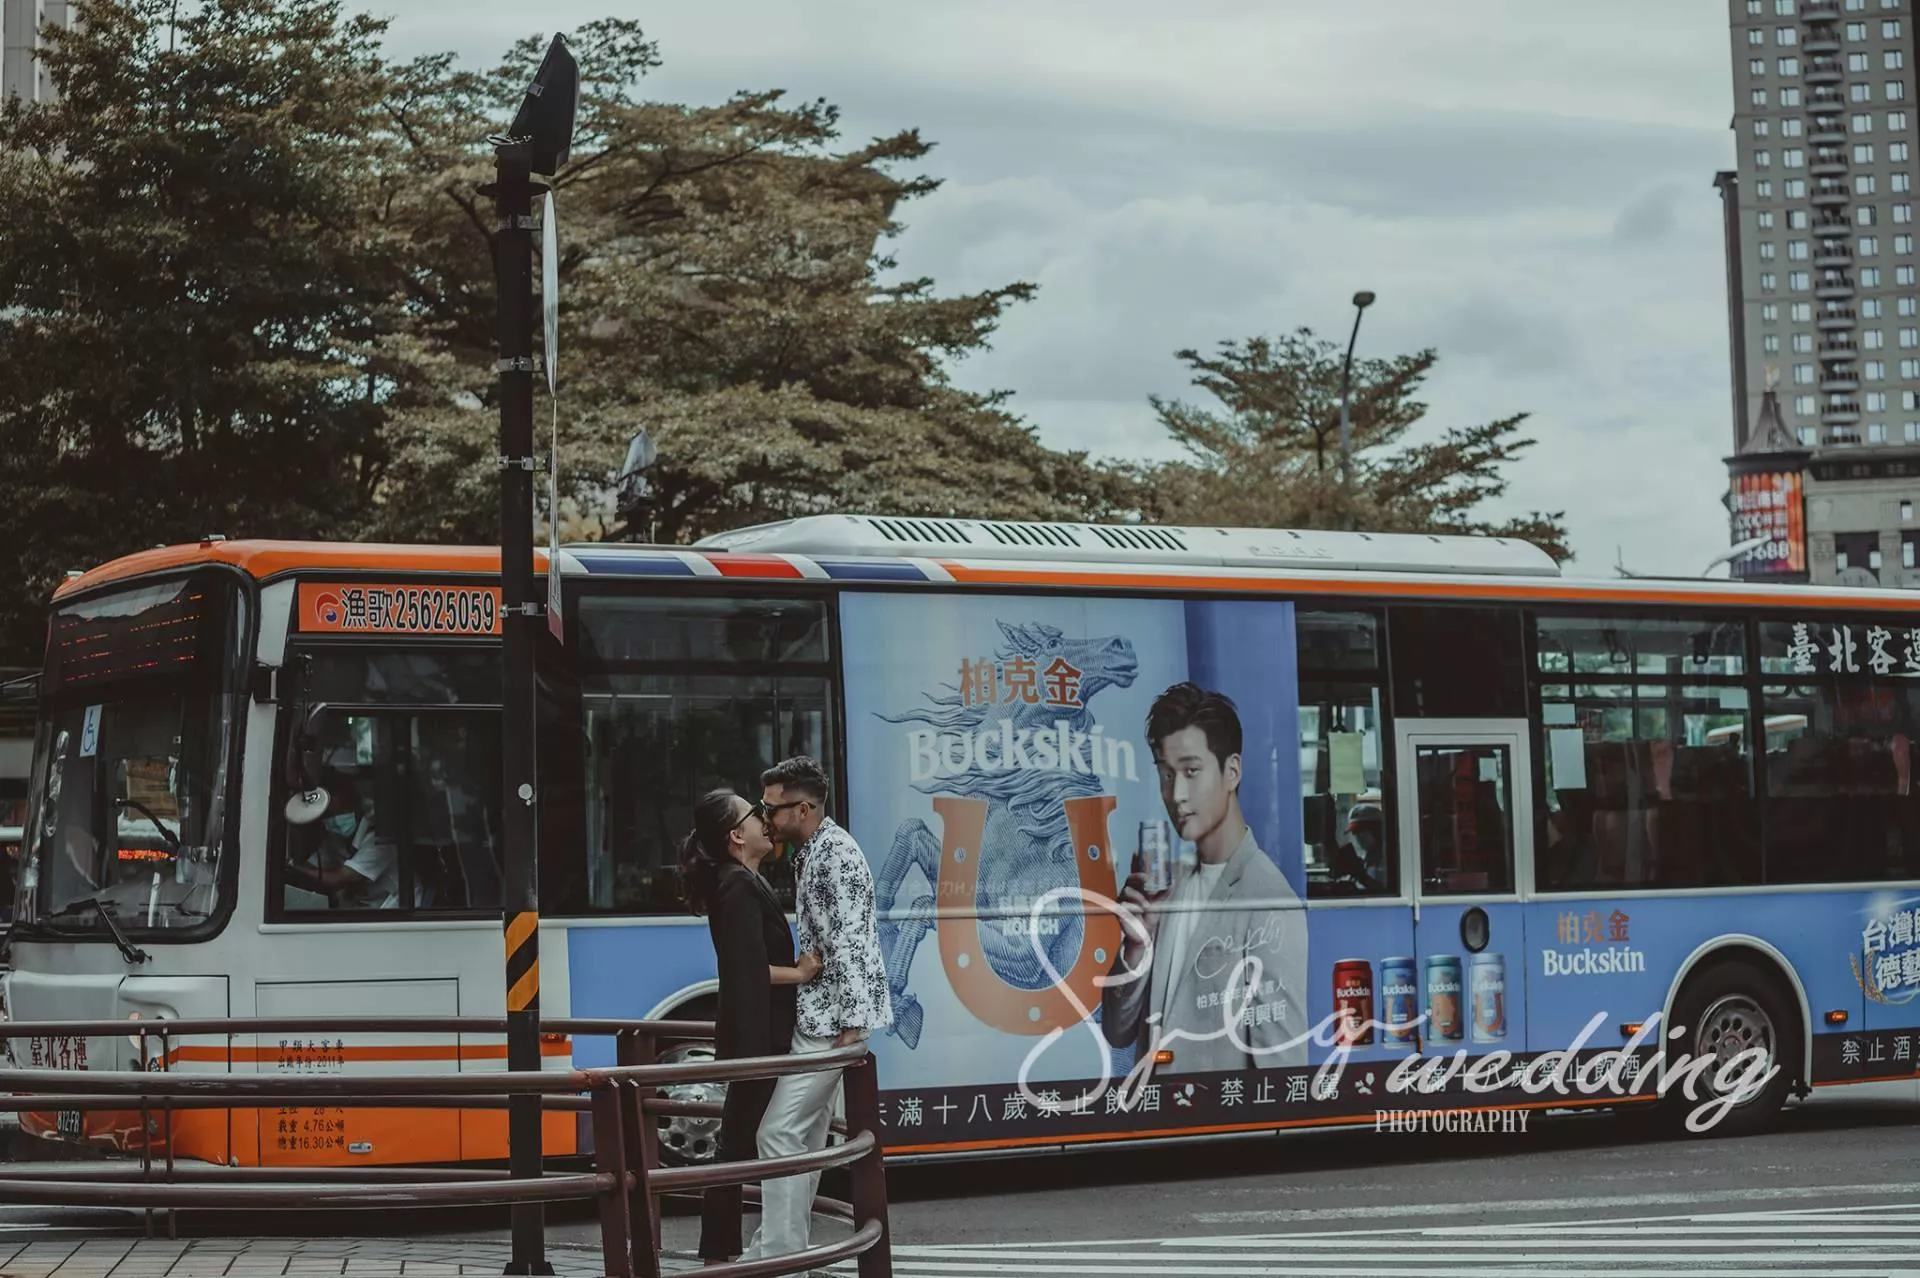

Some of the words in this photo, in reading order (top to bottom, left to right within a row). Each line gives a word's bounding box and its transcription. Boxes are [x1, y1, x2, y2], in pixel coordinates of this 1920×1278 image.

[341, 588, 496, 632] 漁歌25625059
[958, 655, 1084, 709] 柏克金
[906, 717, 1140, 783] Buckskin
[1557, 907, 1630, 945] 柏克金
[1862, 907, 1920, 955] 台灣
[1542, 946, 1646, 977] Buckskin
[1842, 1035, 1920, 1064] 禁止酒
[1220, 1072, 1340, 1107] 禁止酒駕
